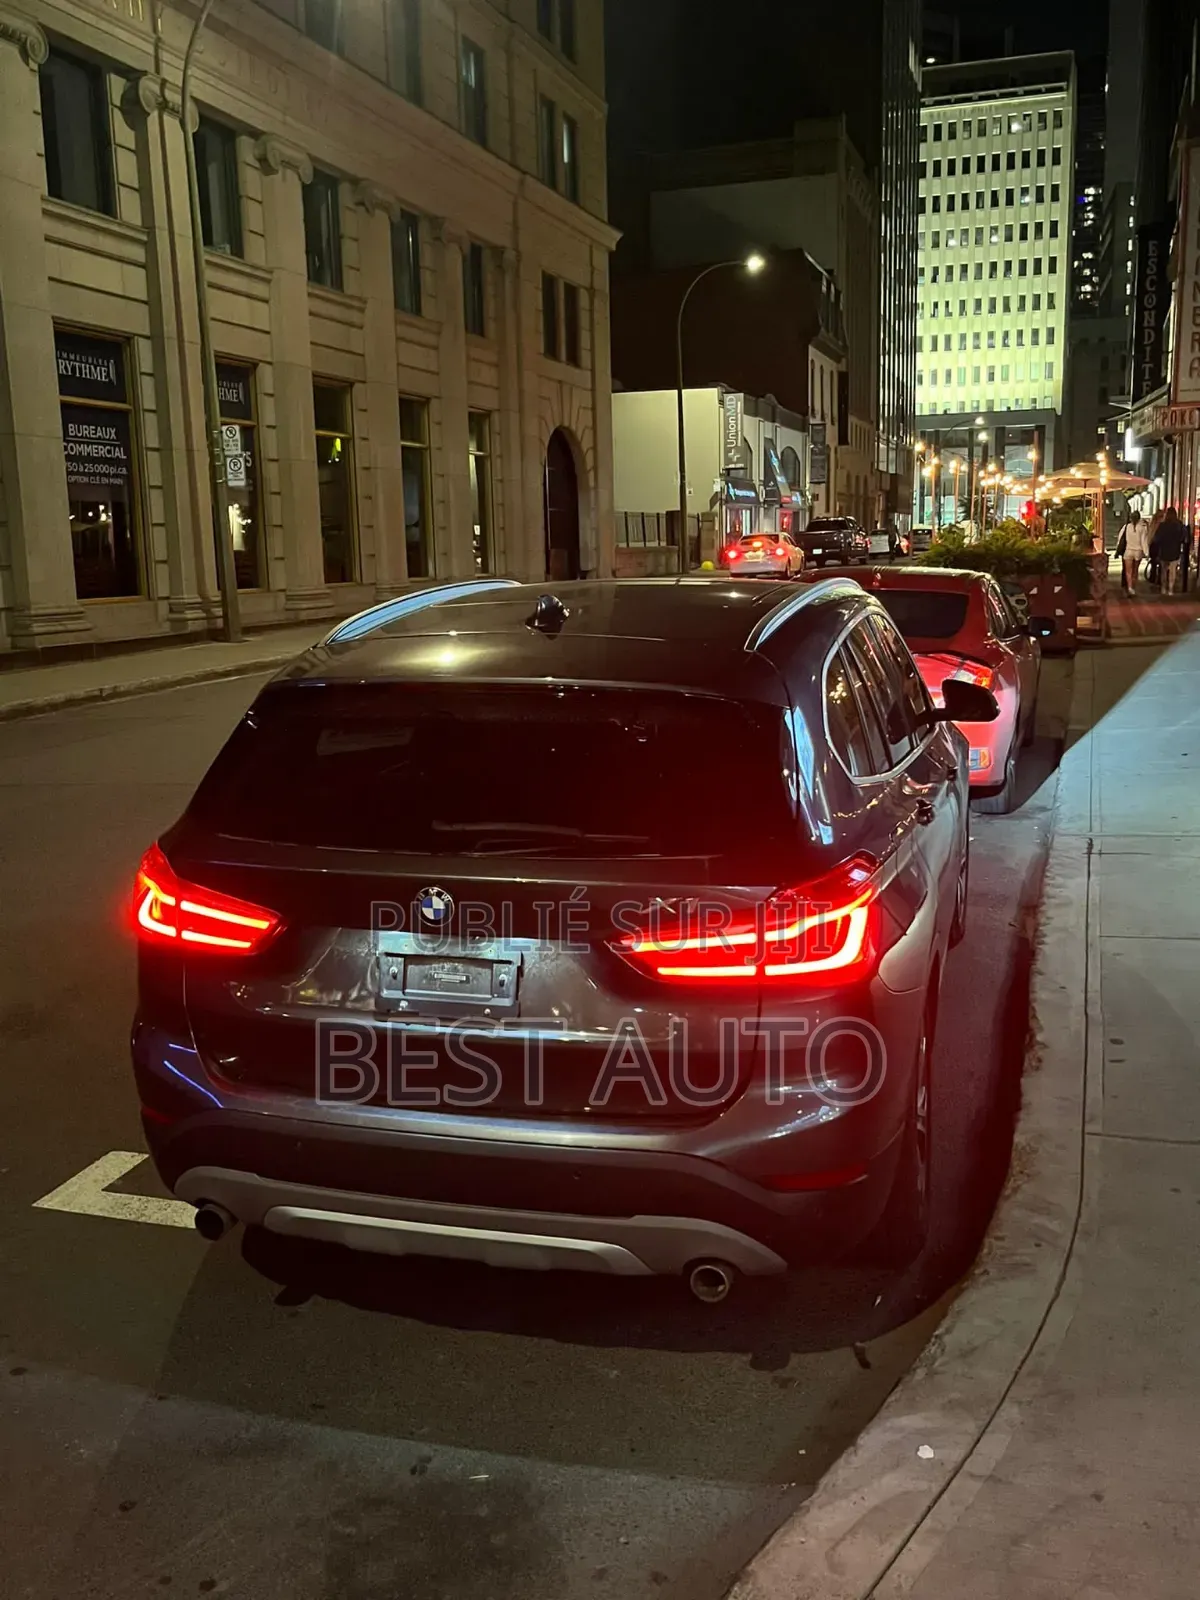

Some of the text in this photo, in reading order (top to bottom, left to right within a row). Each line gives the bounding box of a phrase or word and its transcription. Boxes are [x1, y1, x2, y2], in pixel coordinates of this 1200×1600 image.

[58, 359, 109, 382] RYTHME
[218, 387, 239, 402] HME
[727, 395, 736, 448] UnionMD
[68, 423, 117, 440] BUREAUX
[63, 442, 127, 459] COMMERCIAL
[66, 462, 78, 472] 50
